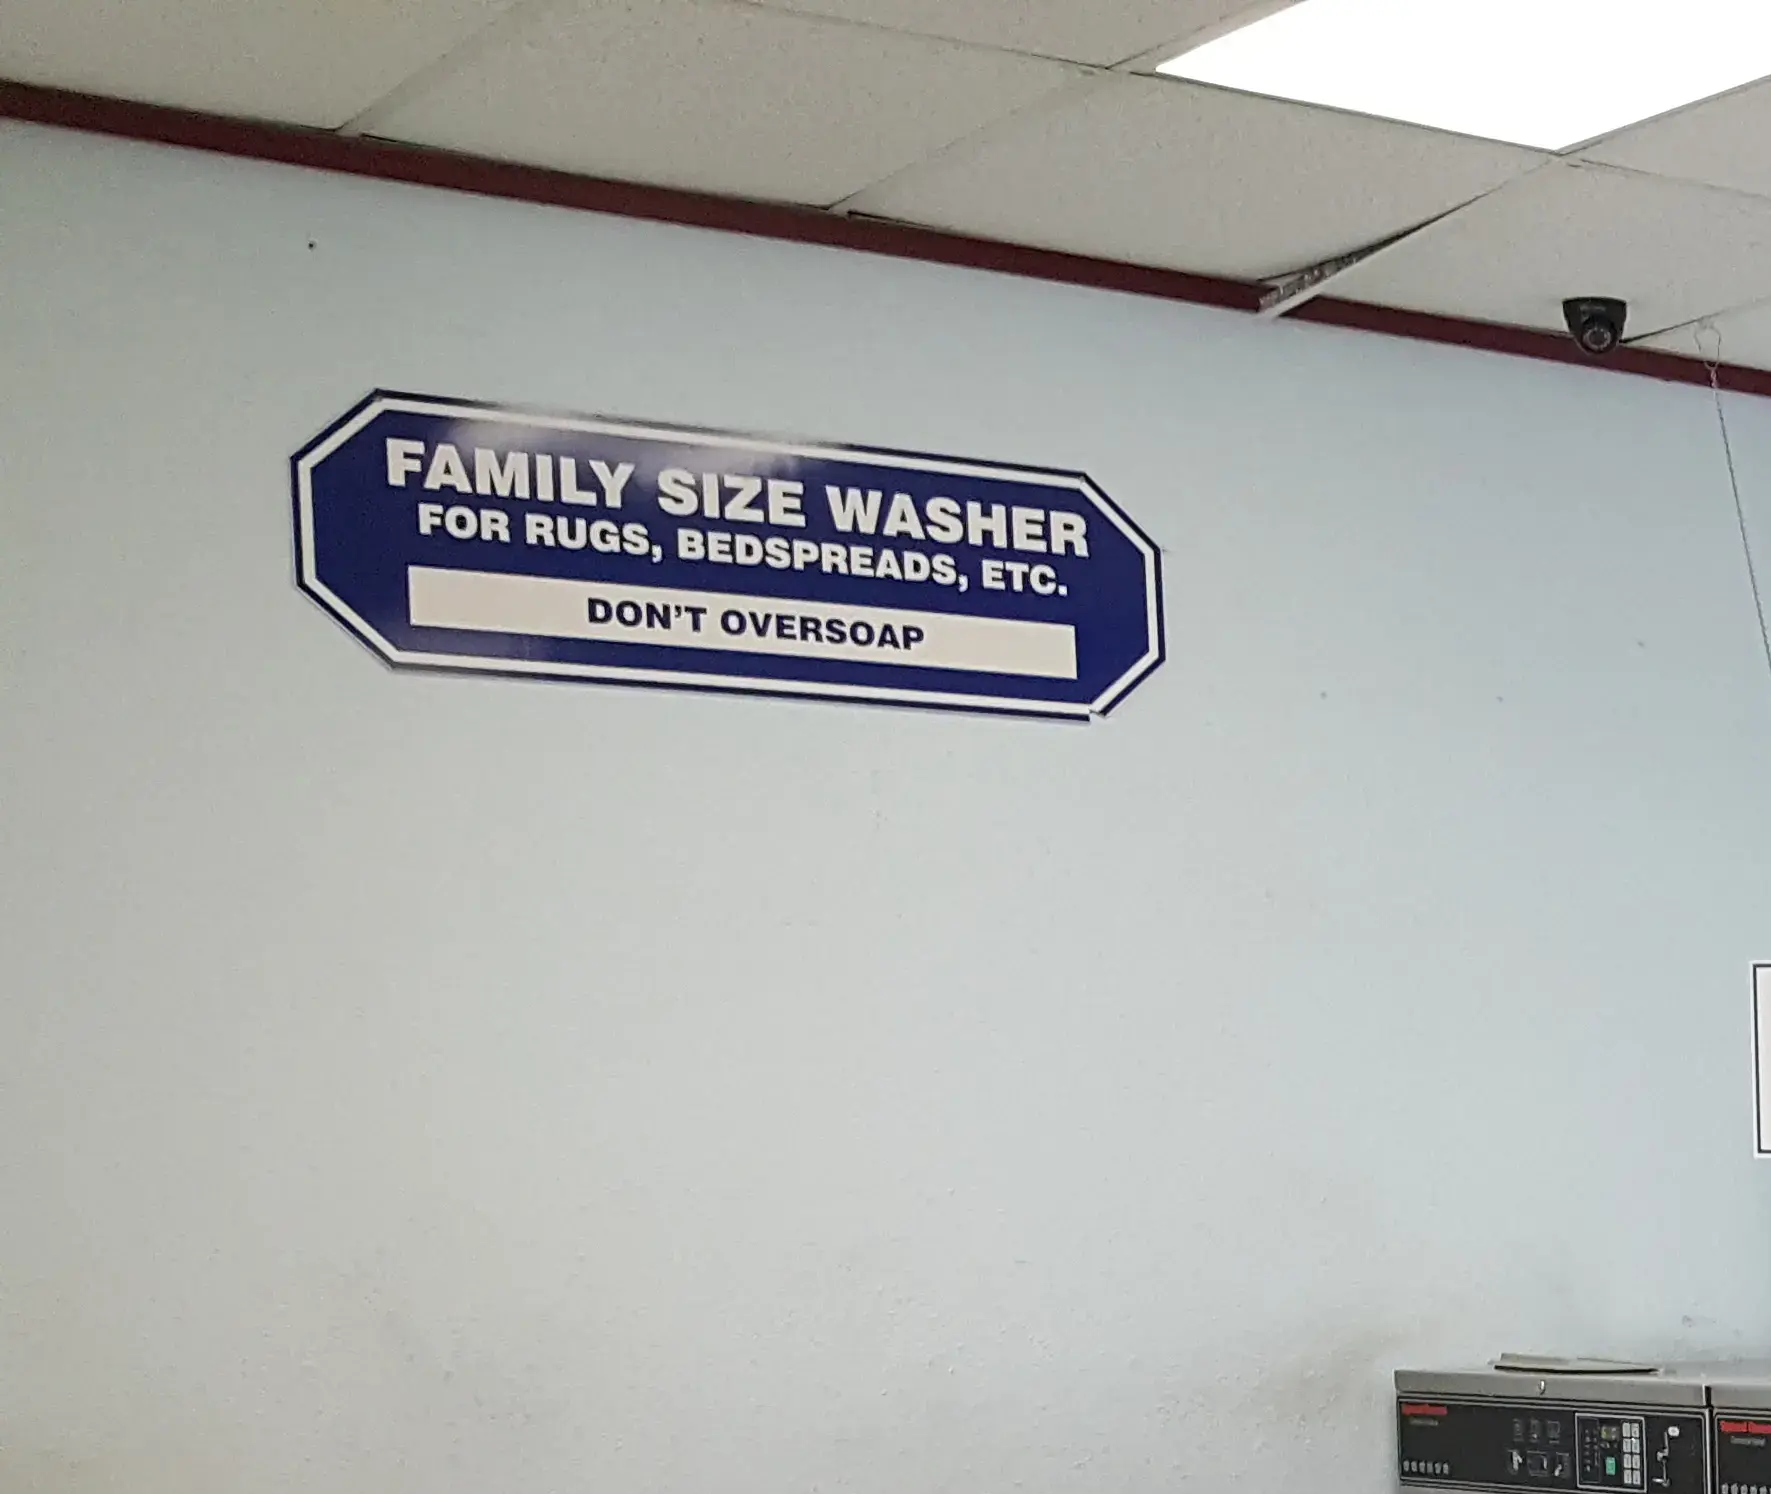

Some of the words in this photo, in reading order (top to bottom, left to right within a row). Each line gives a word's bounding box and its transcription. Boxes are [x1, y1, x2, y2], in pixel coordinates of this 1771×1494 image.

[385, 437, 636, 510] FAMILY
[658, 467, 806, 528] SIZE
[826, 485, 1090, 558] WASHER
[418, 503, 511, 543] FOR
[525, 511, 662, 564] RUGS,
[677, 528, 970, 593] BEDSPREADS,
[981, 559, 1069, 597] ETC.
[587, 597, 707, 634] DON'T
[720, 608, 925, 651] OVERSOAP
